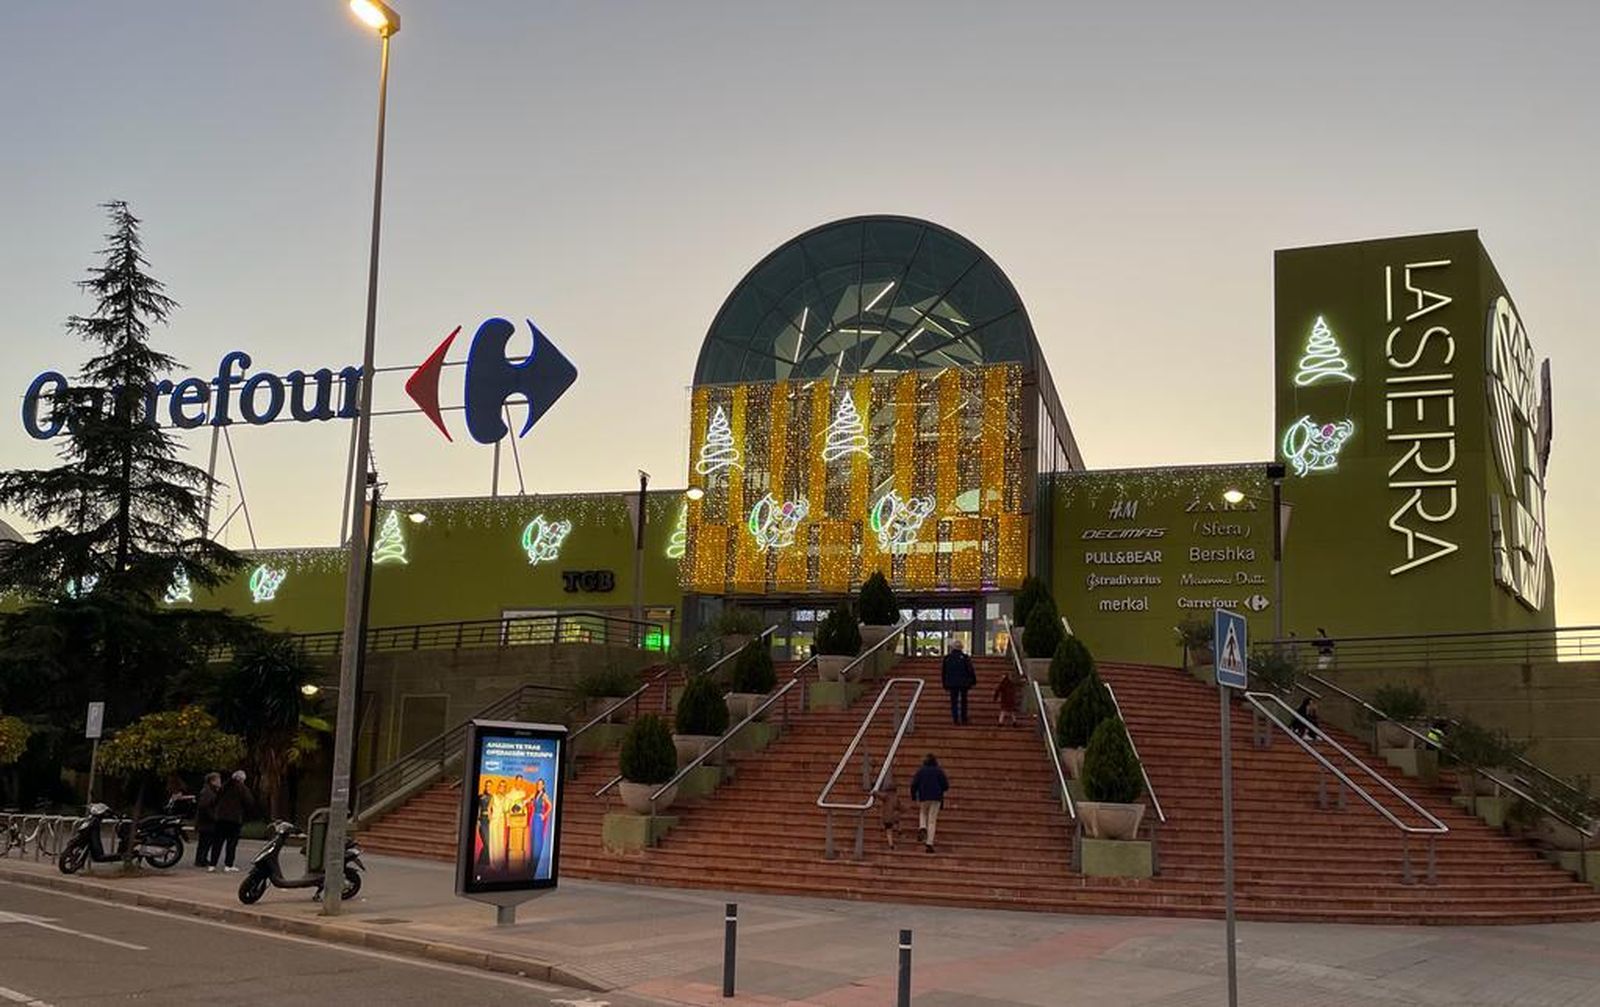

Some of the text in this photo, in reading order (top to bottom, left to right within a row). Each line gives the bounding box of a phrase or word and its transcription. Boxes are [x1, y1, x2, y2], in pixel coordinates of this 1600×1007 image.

[1385, 259, 1459, 576] LA SIERRA
[1109, 500, 1138, 520] H&M
[1082, 528, 1167, 539] DECIMAS
[1085, 550, 1162, 564] PULL&BEAR
[1189, 546, 1255, 561] Bershka
[563, 571, 614, 592] TGB
[1100, 596, 1149, 611] merkal
[1177, 597, 1239, 609] Carrefour
